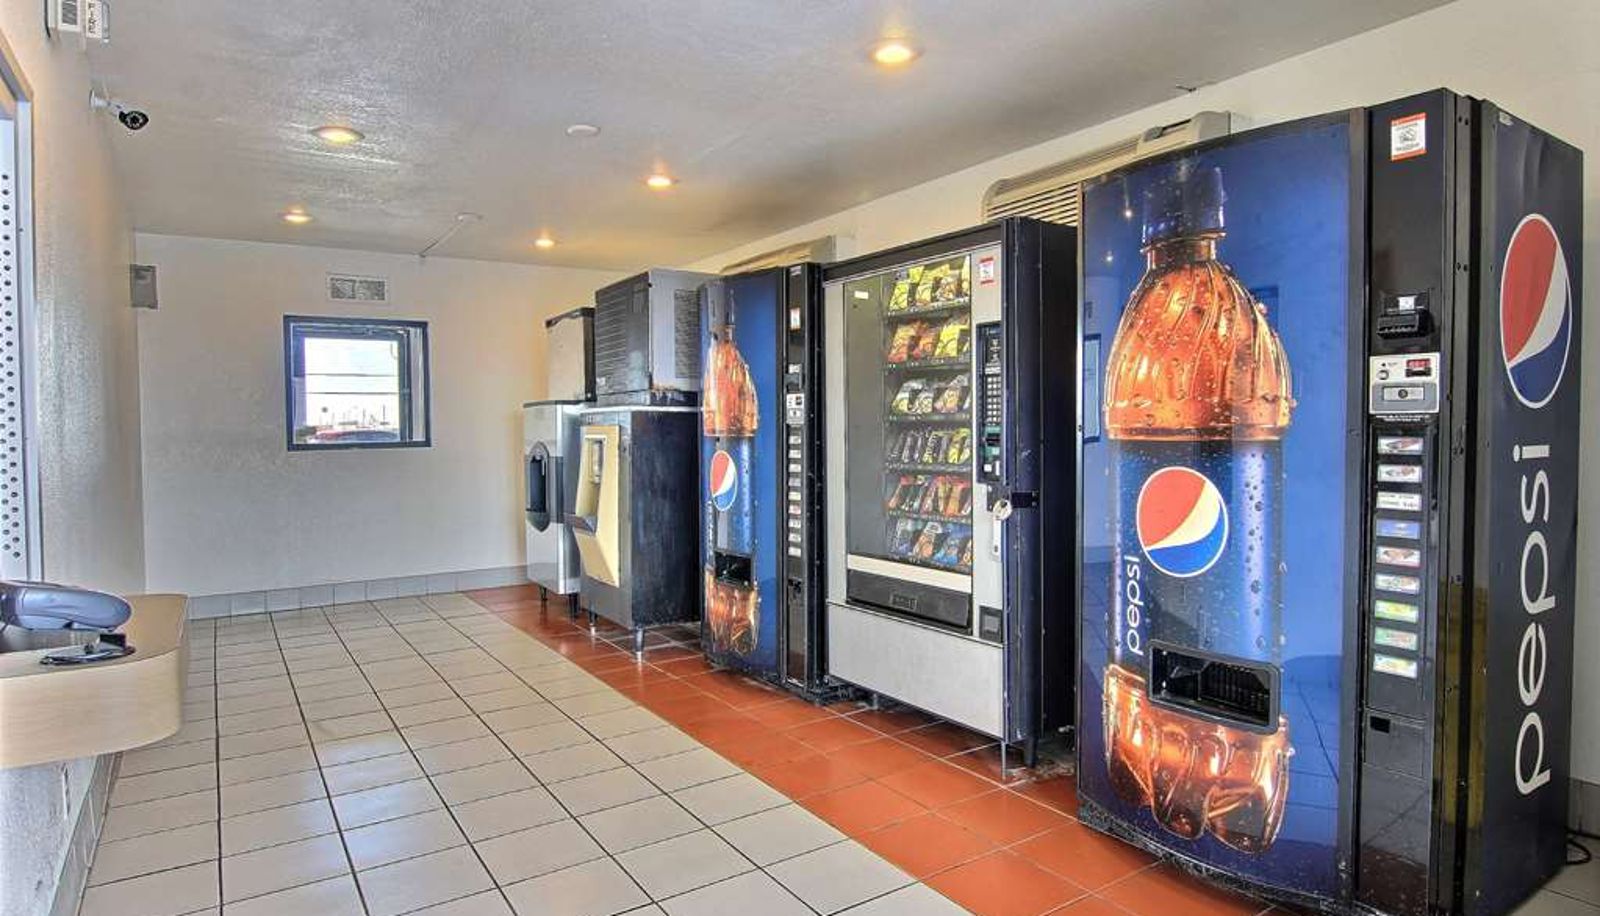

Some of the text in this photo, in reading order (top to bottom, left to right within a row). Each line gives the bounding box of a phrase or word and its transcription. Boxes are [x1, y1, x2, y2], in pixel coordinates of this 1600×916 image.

[88, 2, 97, 34] FIRE
[1124, 555, 1145, 656] pepsi
[1512, 443, 1556, 795] pepsi
